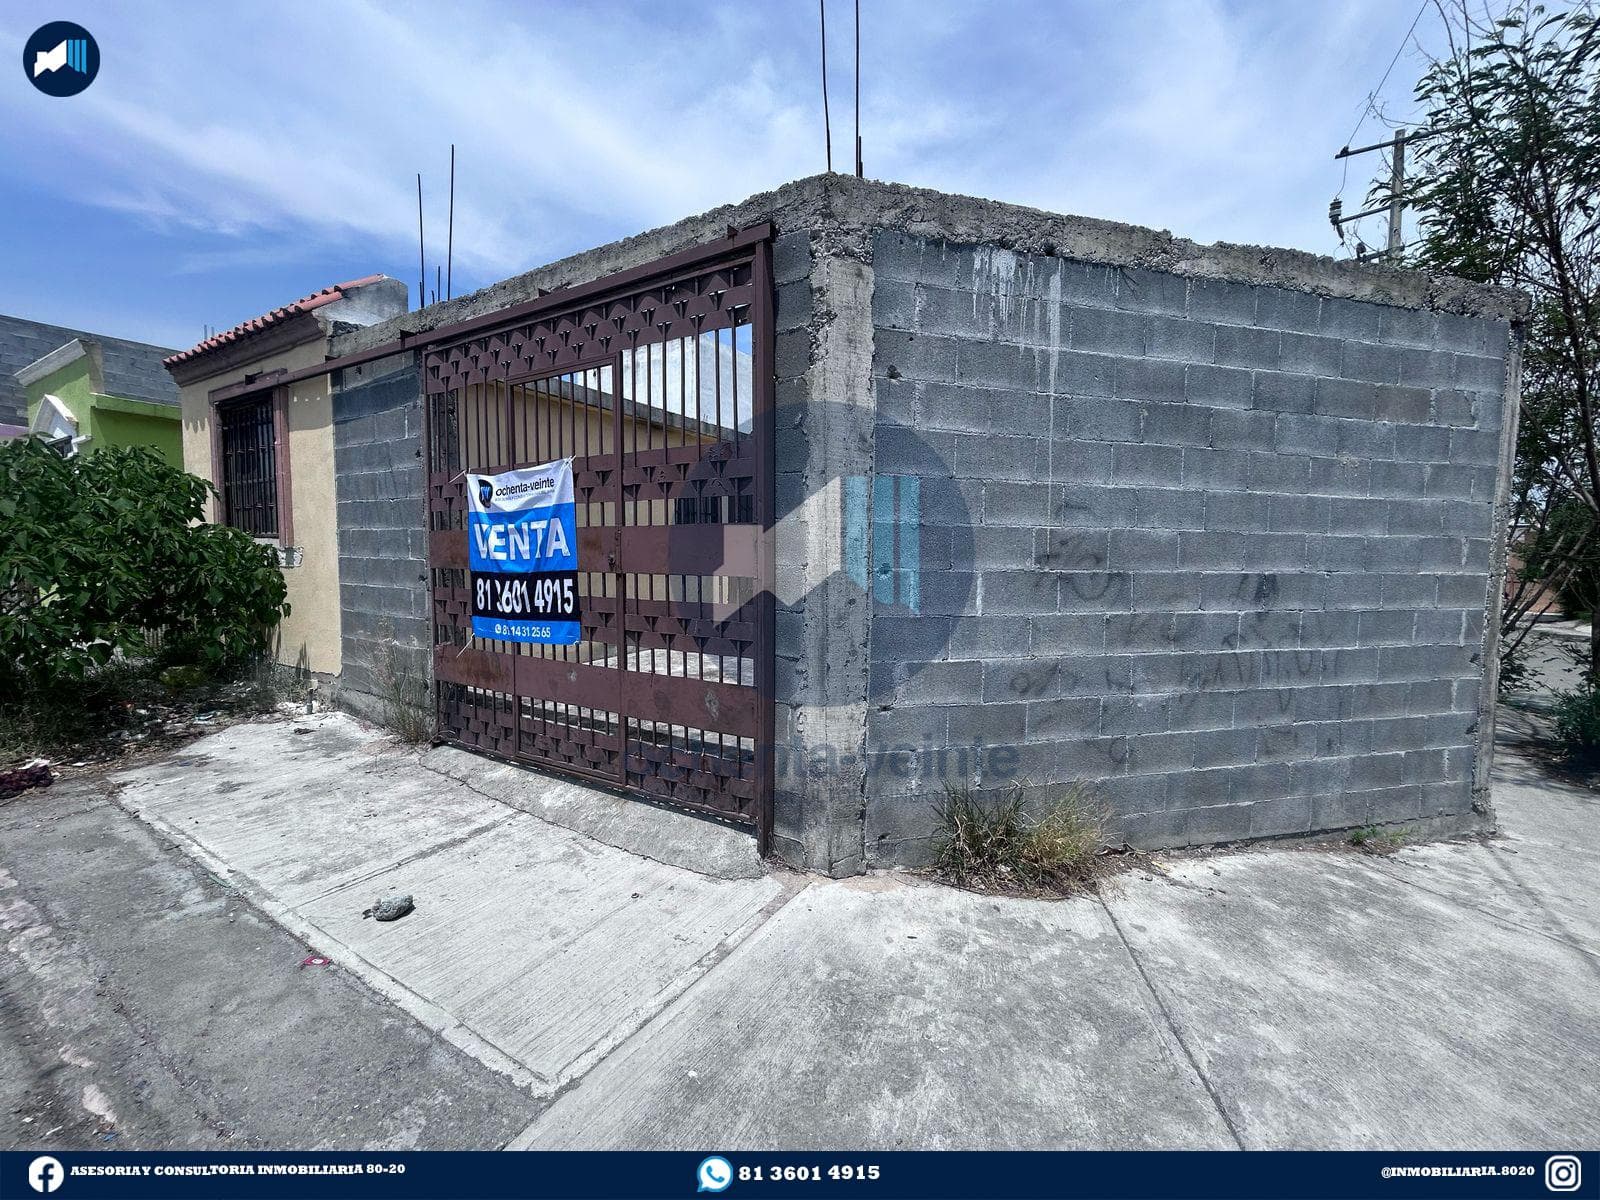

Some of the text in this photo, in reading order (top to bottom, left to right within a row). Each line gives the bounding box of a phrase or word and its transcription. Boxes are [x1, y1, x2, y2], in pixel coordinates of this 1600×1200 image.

[496, 478, 555, 497] ochenta-veinte
[474, 518, 571, 560] VENTA
[477, 578, 491, 611] 81
[535, 578, 574, 614] 4915
